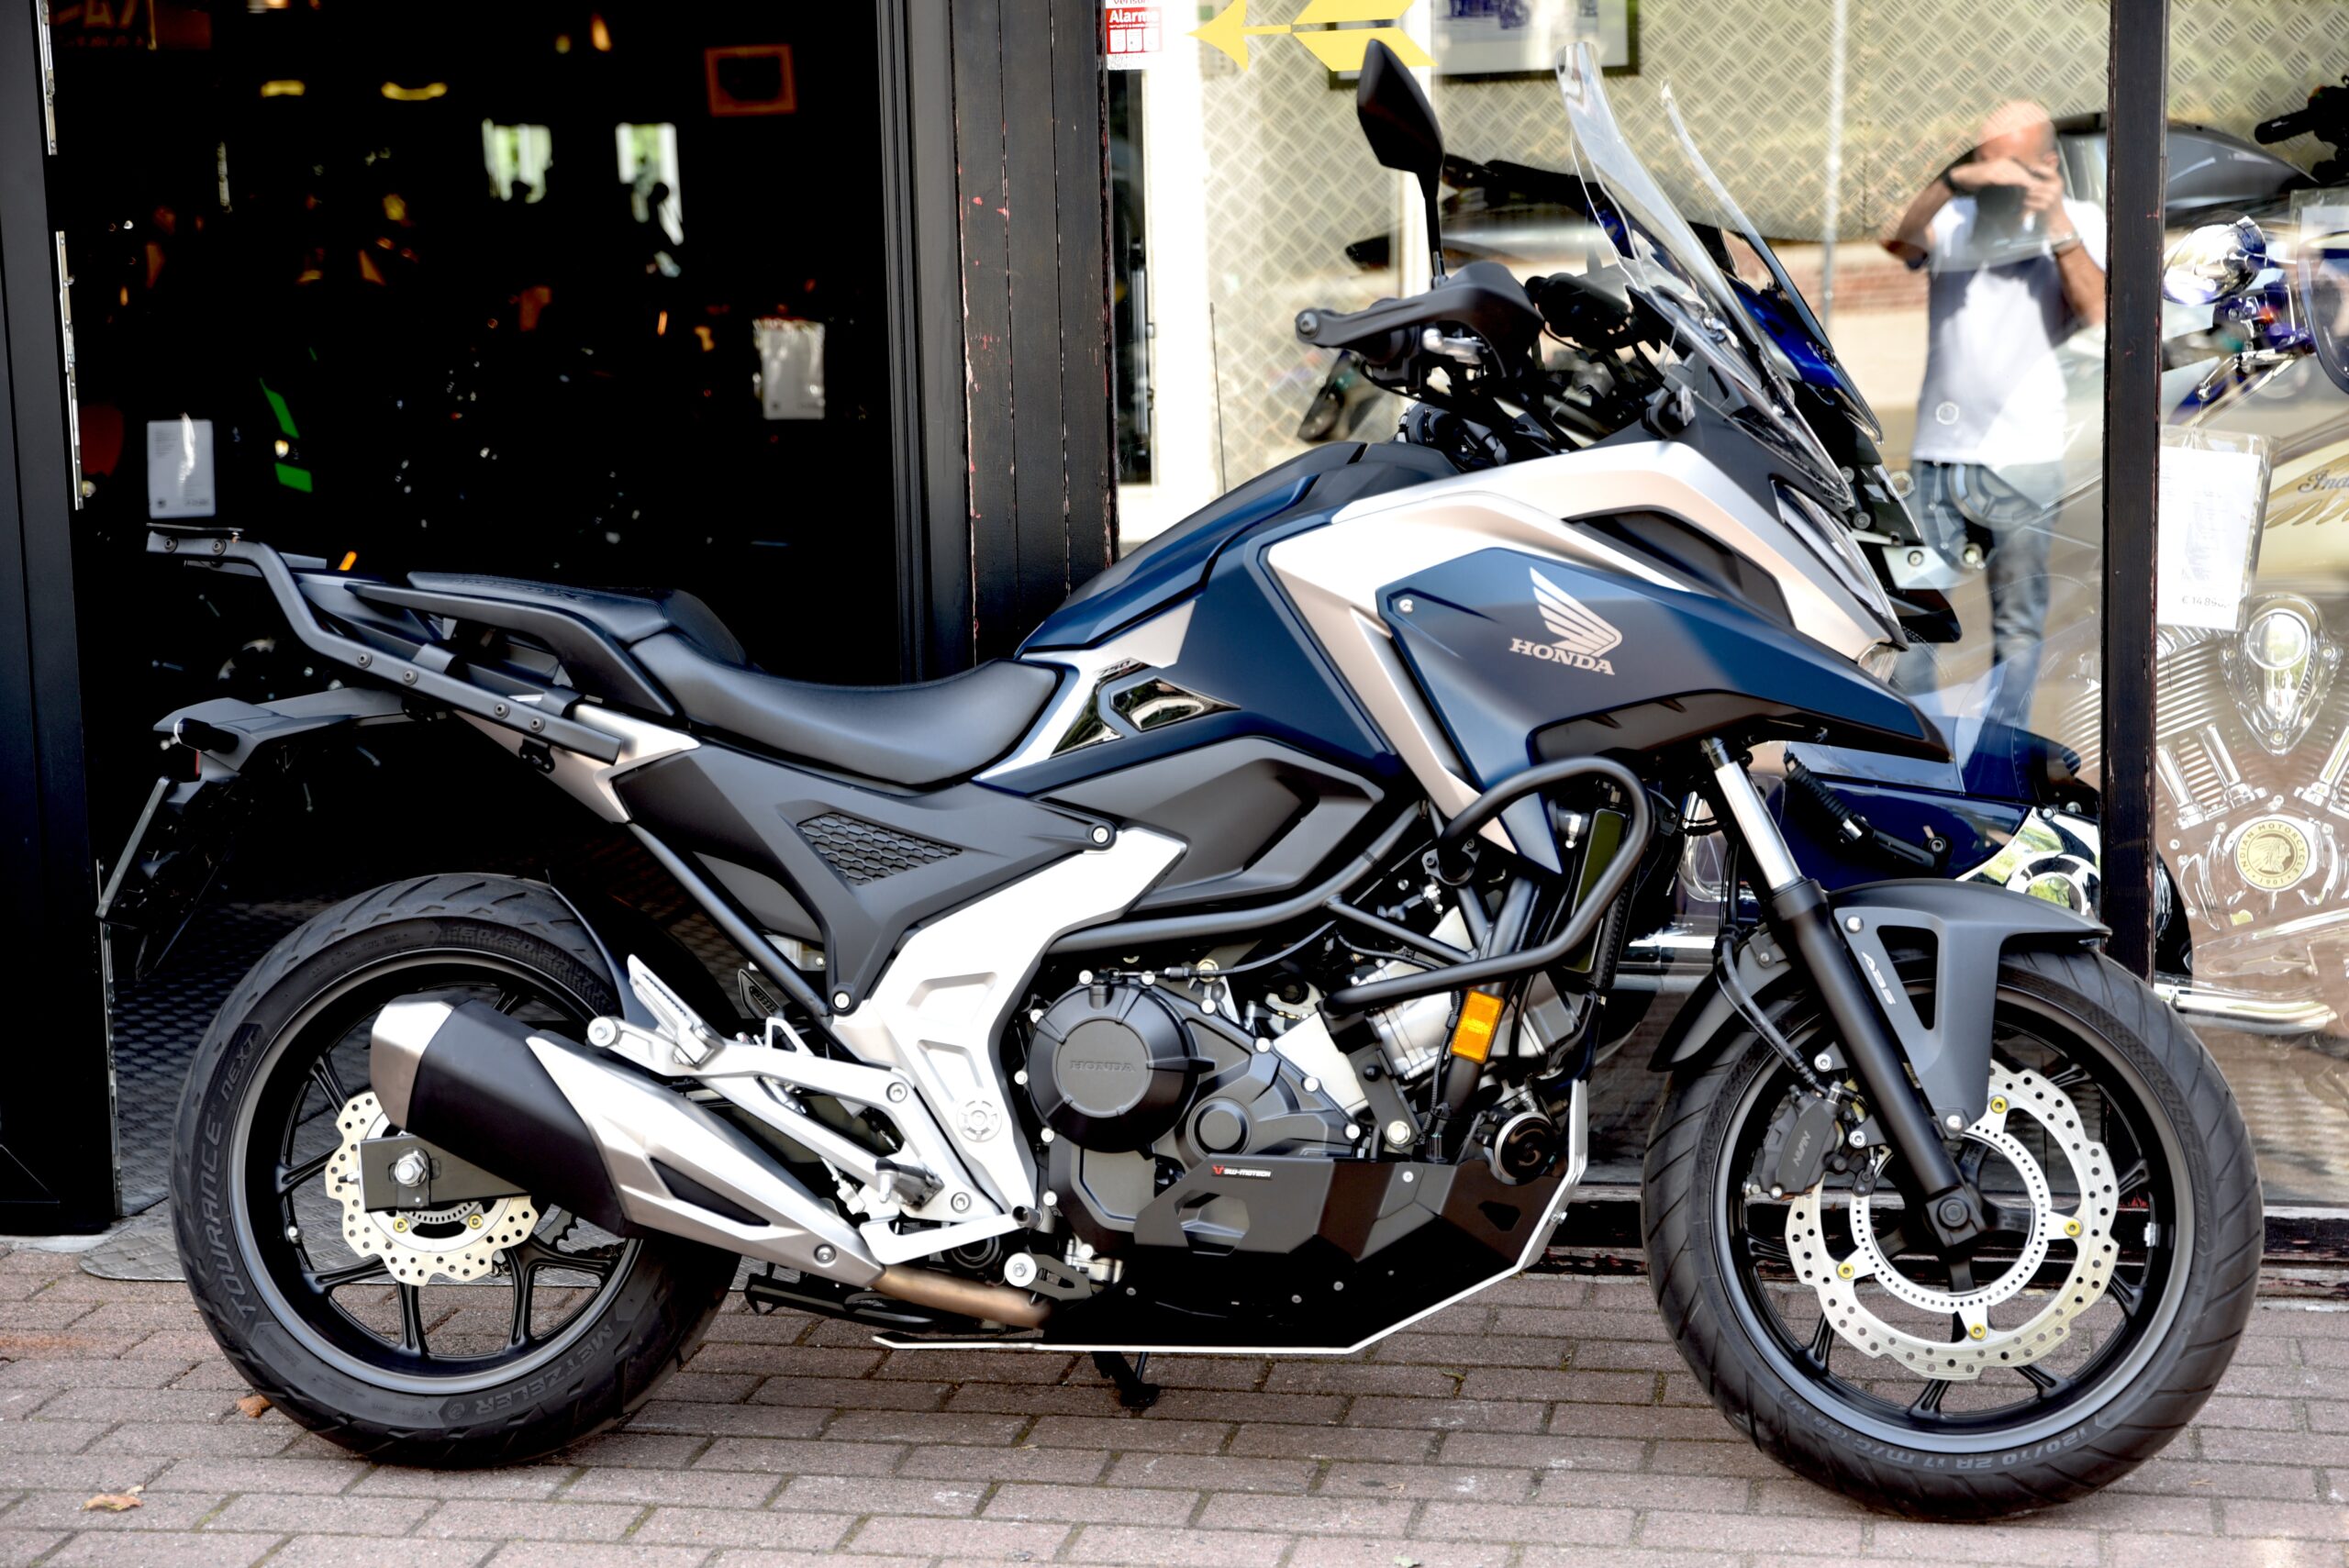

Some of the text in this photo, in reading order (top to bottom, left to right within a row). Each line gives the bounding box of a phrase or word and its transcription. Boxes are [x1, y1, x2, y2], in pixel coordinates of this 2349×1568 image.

[1508, 638, 1616, 675] HONDA
[2239, 822, 2306, 874] INDIAN MOTORCYCLE
[1861, 951, 1898, 1005] ABS
[1069, 1061, 1137, 1073] HONDA
[200, 1031, 258, 1319] TOURANCE NEXT
[1223, 1167, 1272, 1177] SW-MOTECH
[475, 1324, 616, 1415] METZELER
